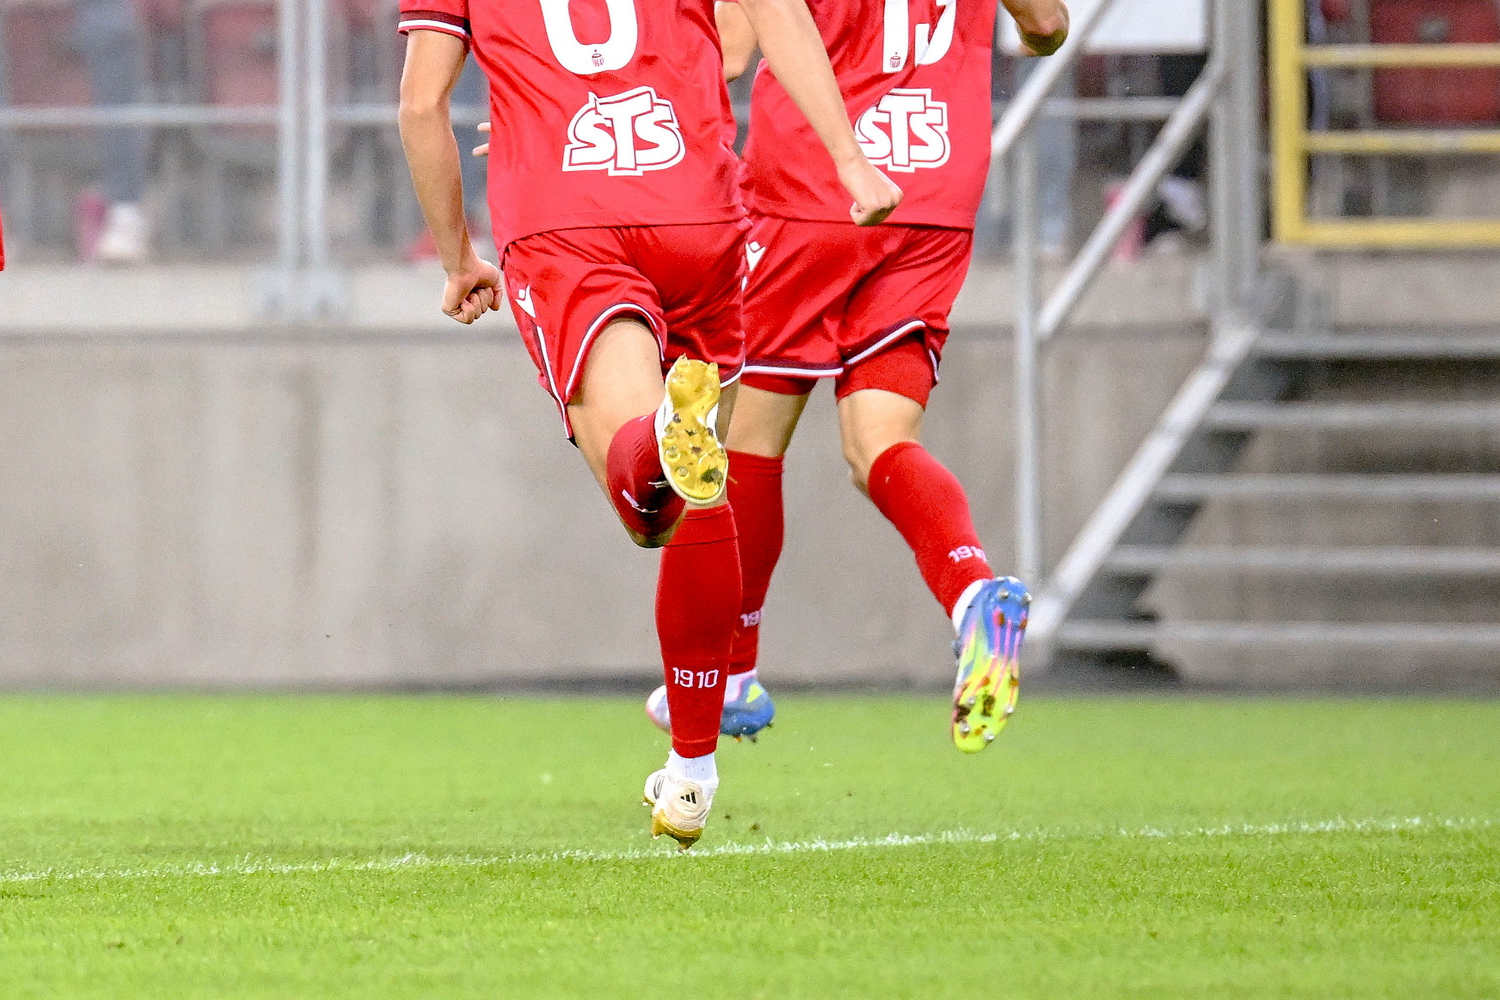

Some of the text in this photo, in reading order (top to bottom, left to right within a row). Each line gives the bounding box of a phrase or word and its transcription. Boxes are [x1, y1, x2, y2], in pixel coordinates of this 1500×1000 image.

[561, 85, 686, 176] STS
[854, 88, 950, 173] STS
[673, 667, 719, 688] 1910
